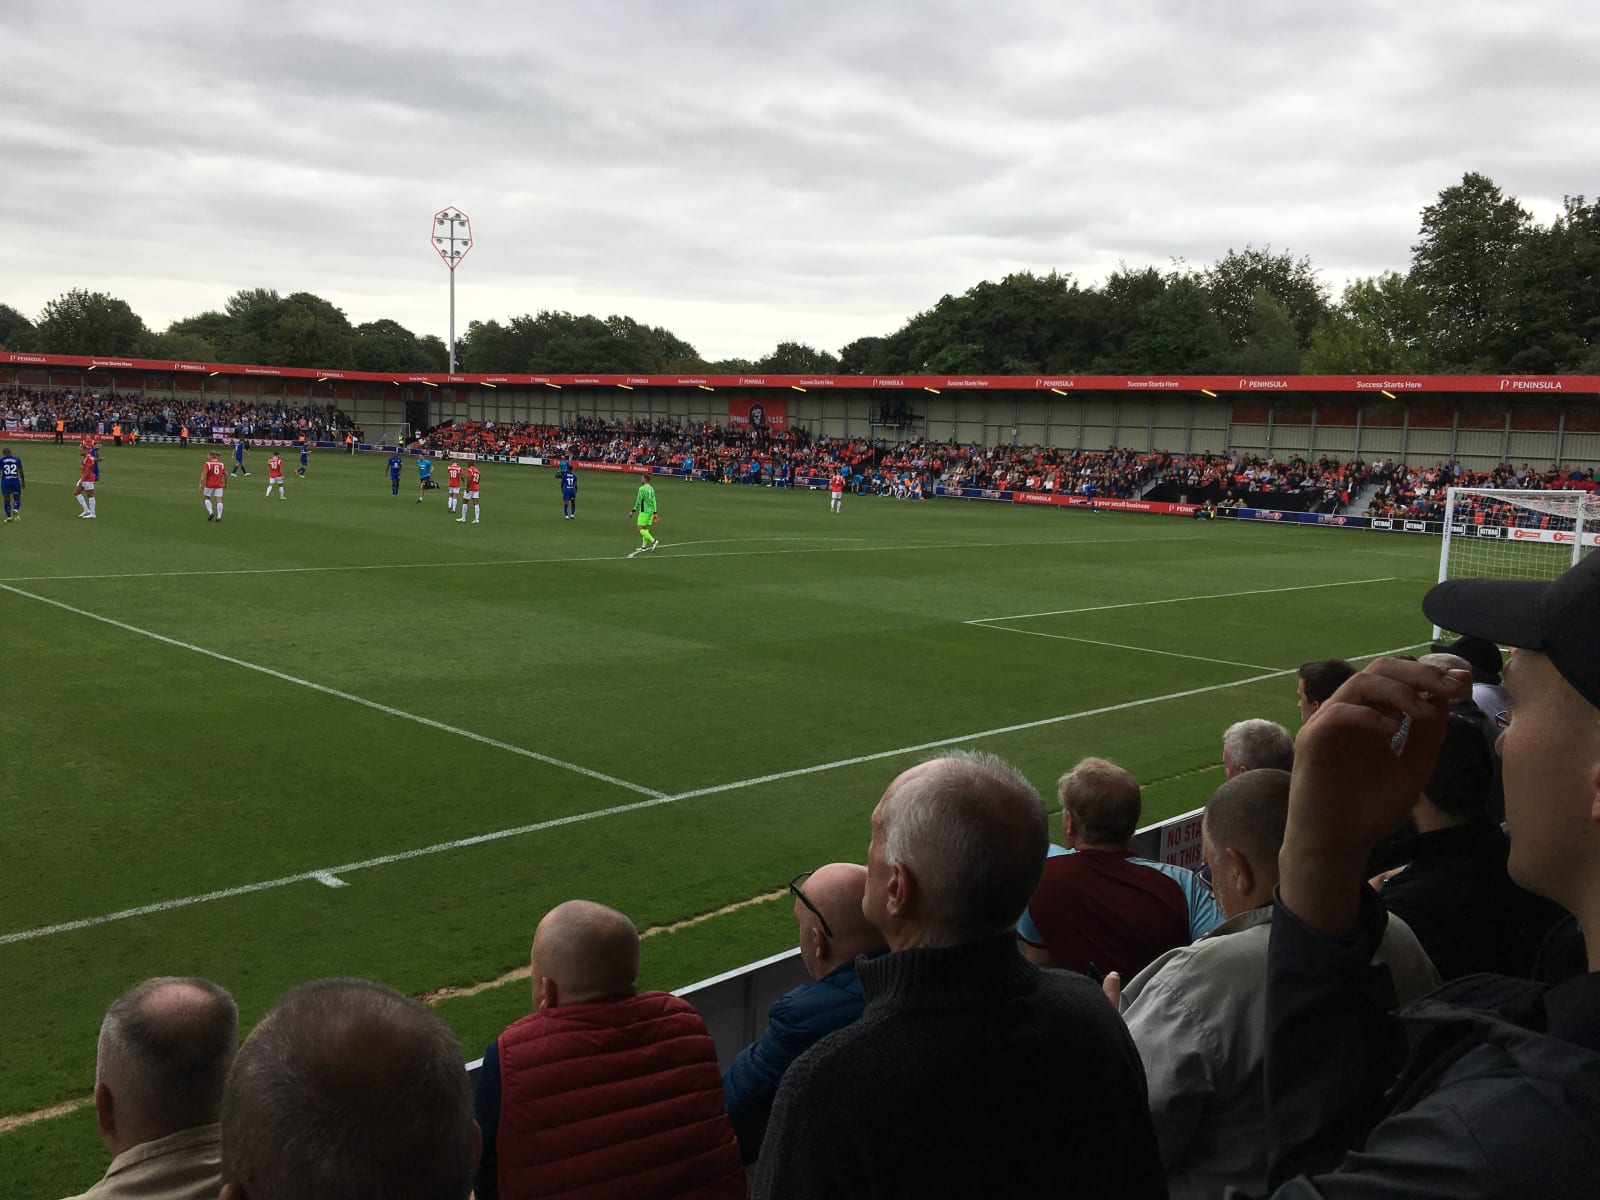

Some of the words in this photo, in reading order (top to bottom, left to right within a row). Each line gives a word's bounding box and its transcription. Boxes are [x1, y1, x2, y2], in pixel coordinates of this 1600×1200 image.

[4, 464, 17, 475] 32
[214, 465, 220, 475] 6
[1167, 827, 1181, 848] NO
[1184, 820, 1202, 842] STA
[1180, 843, 1202, 867] THIS
